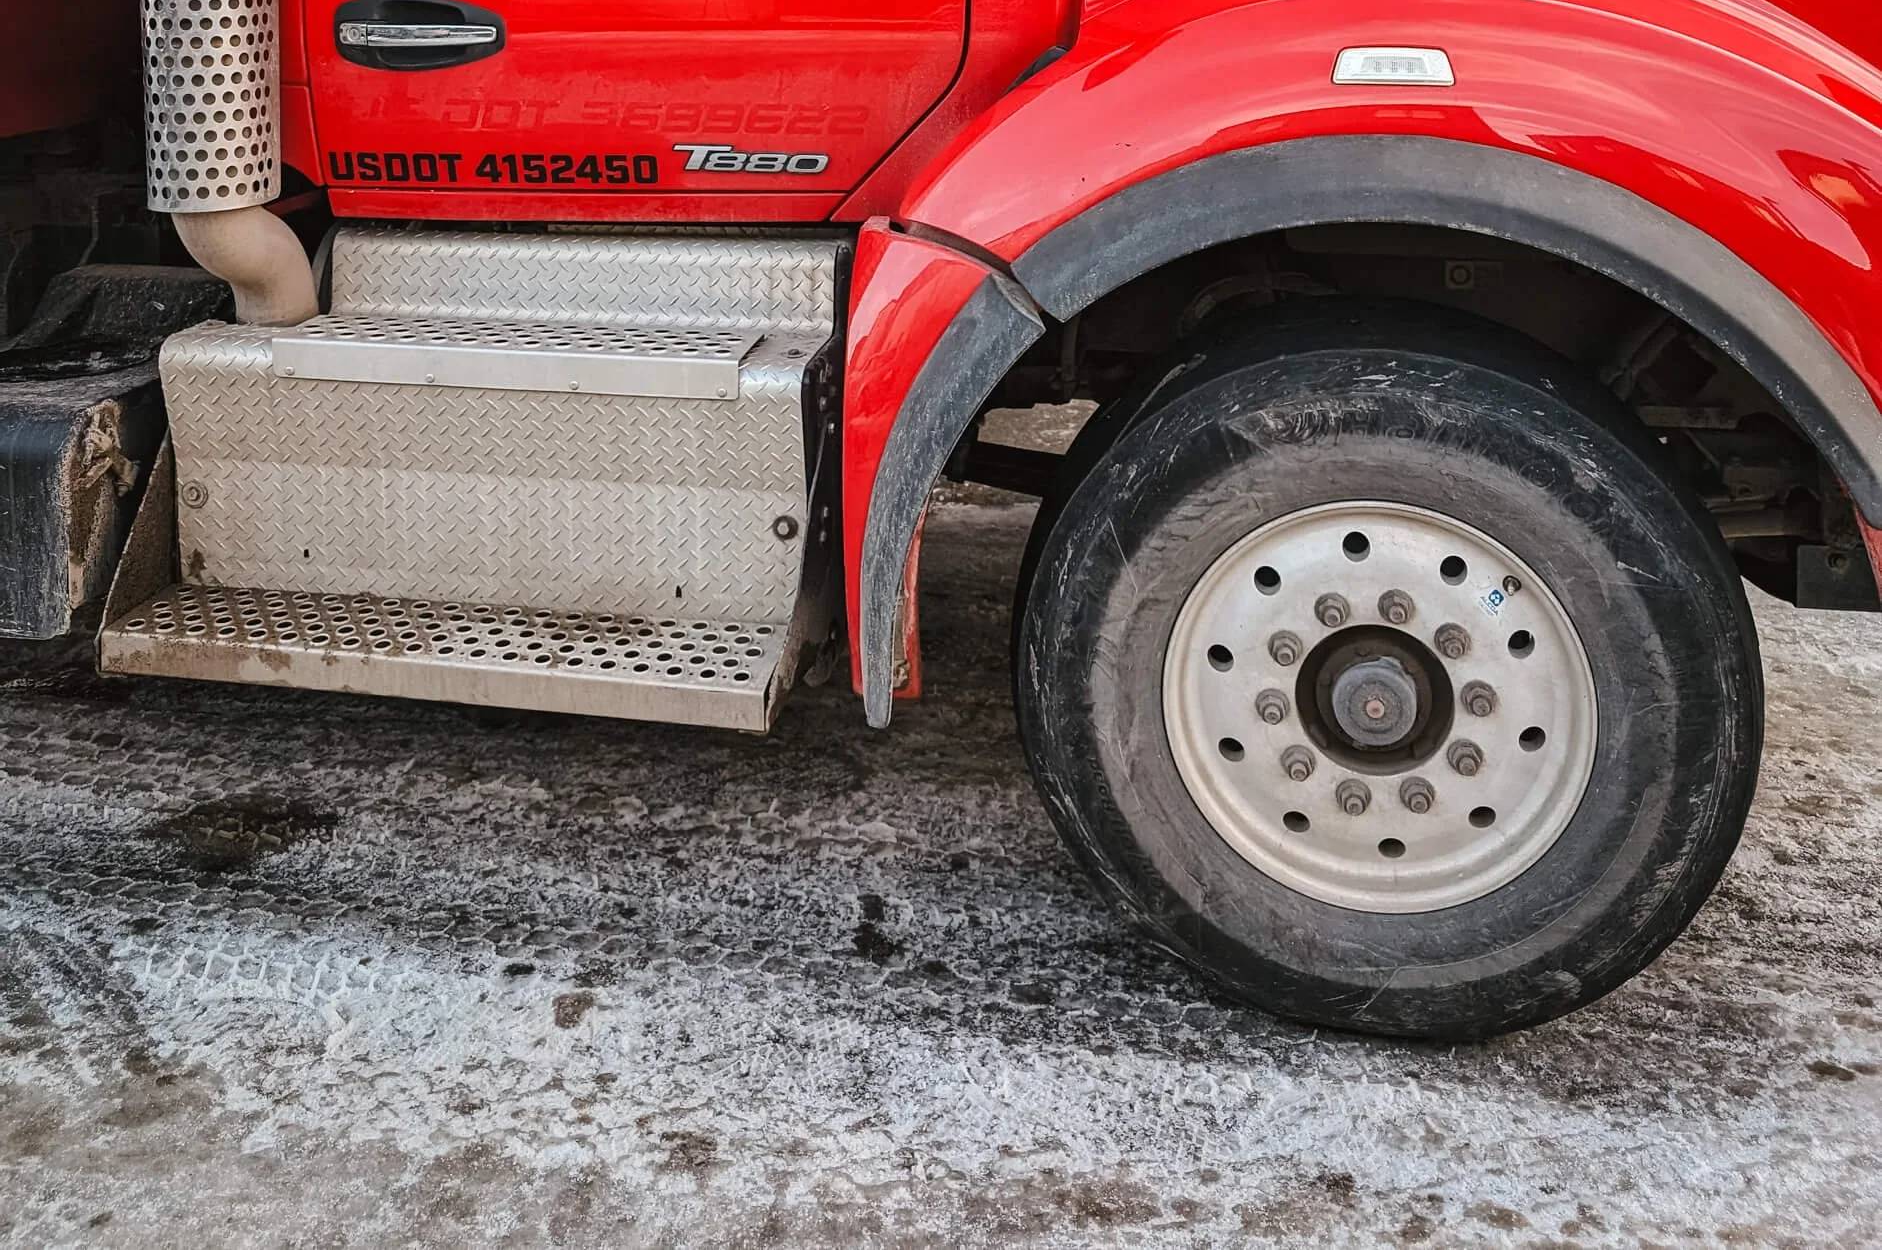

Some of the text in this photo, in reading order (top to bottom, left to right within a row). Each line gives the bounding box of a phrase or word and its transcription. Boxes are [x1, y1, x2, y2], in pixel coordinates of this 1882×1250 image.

[327, 152, 659, 185] USDOT 4152450
[673, 144, 829, 174] T880
